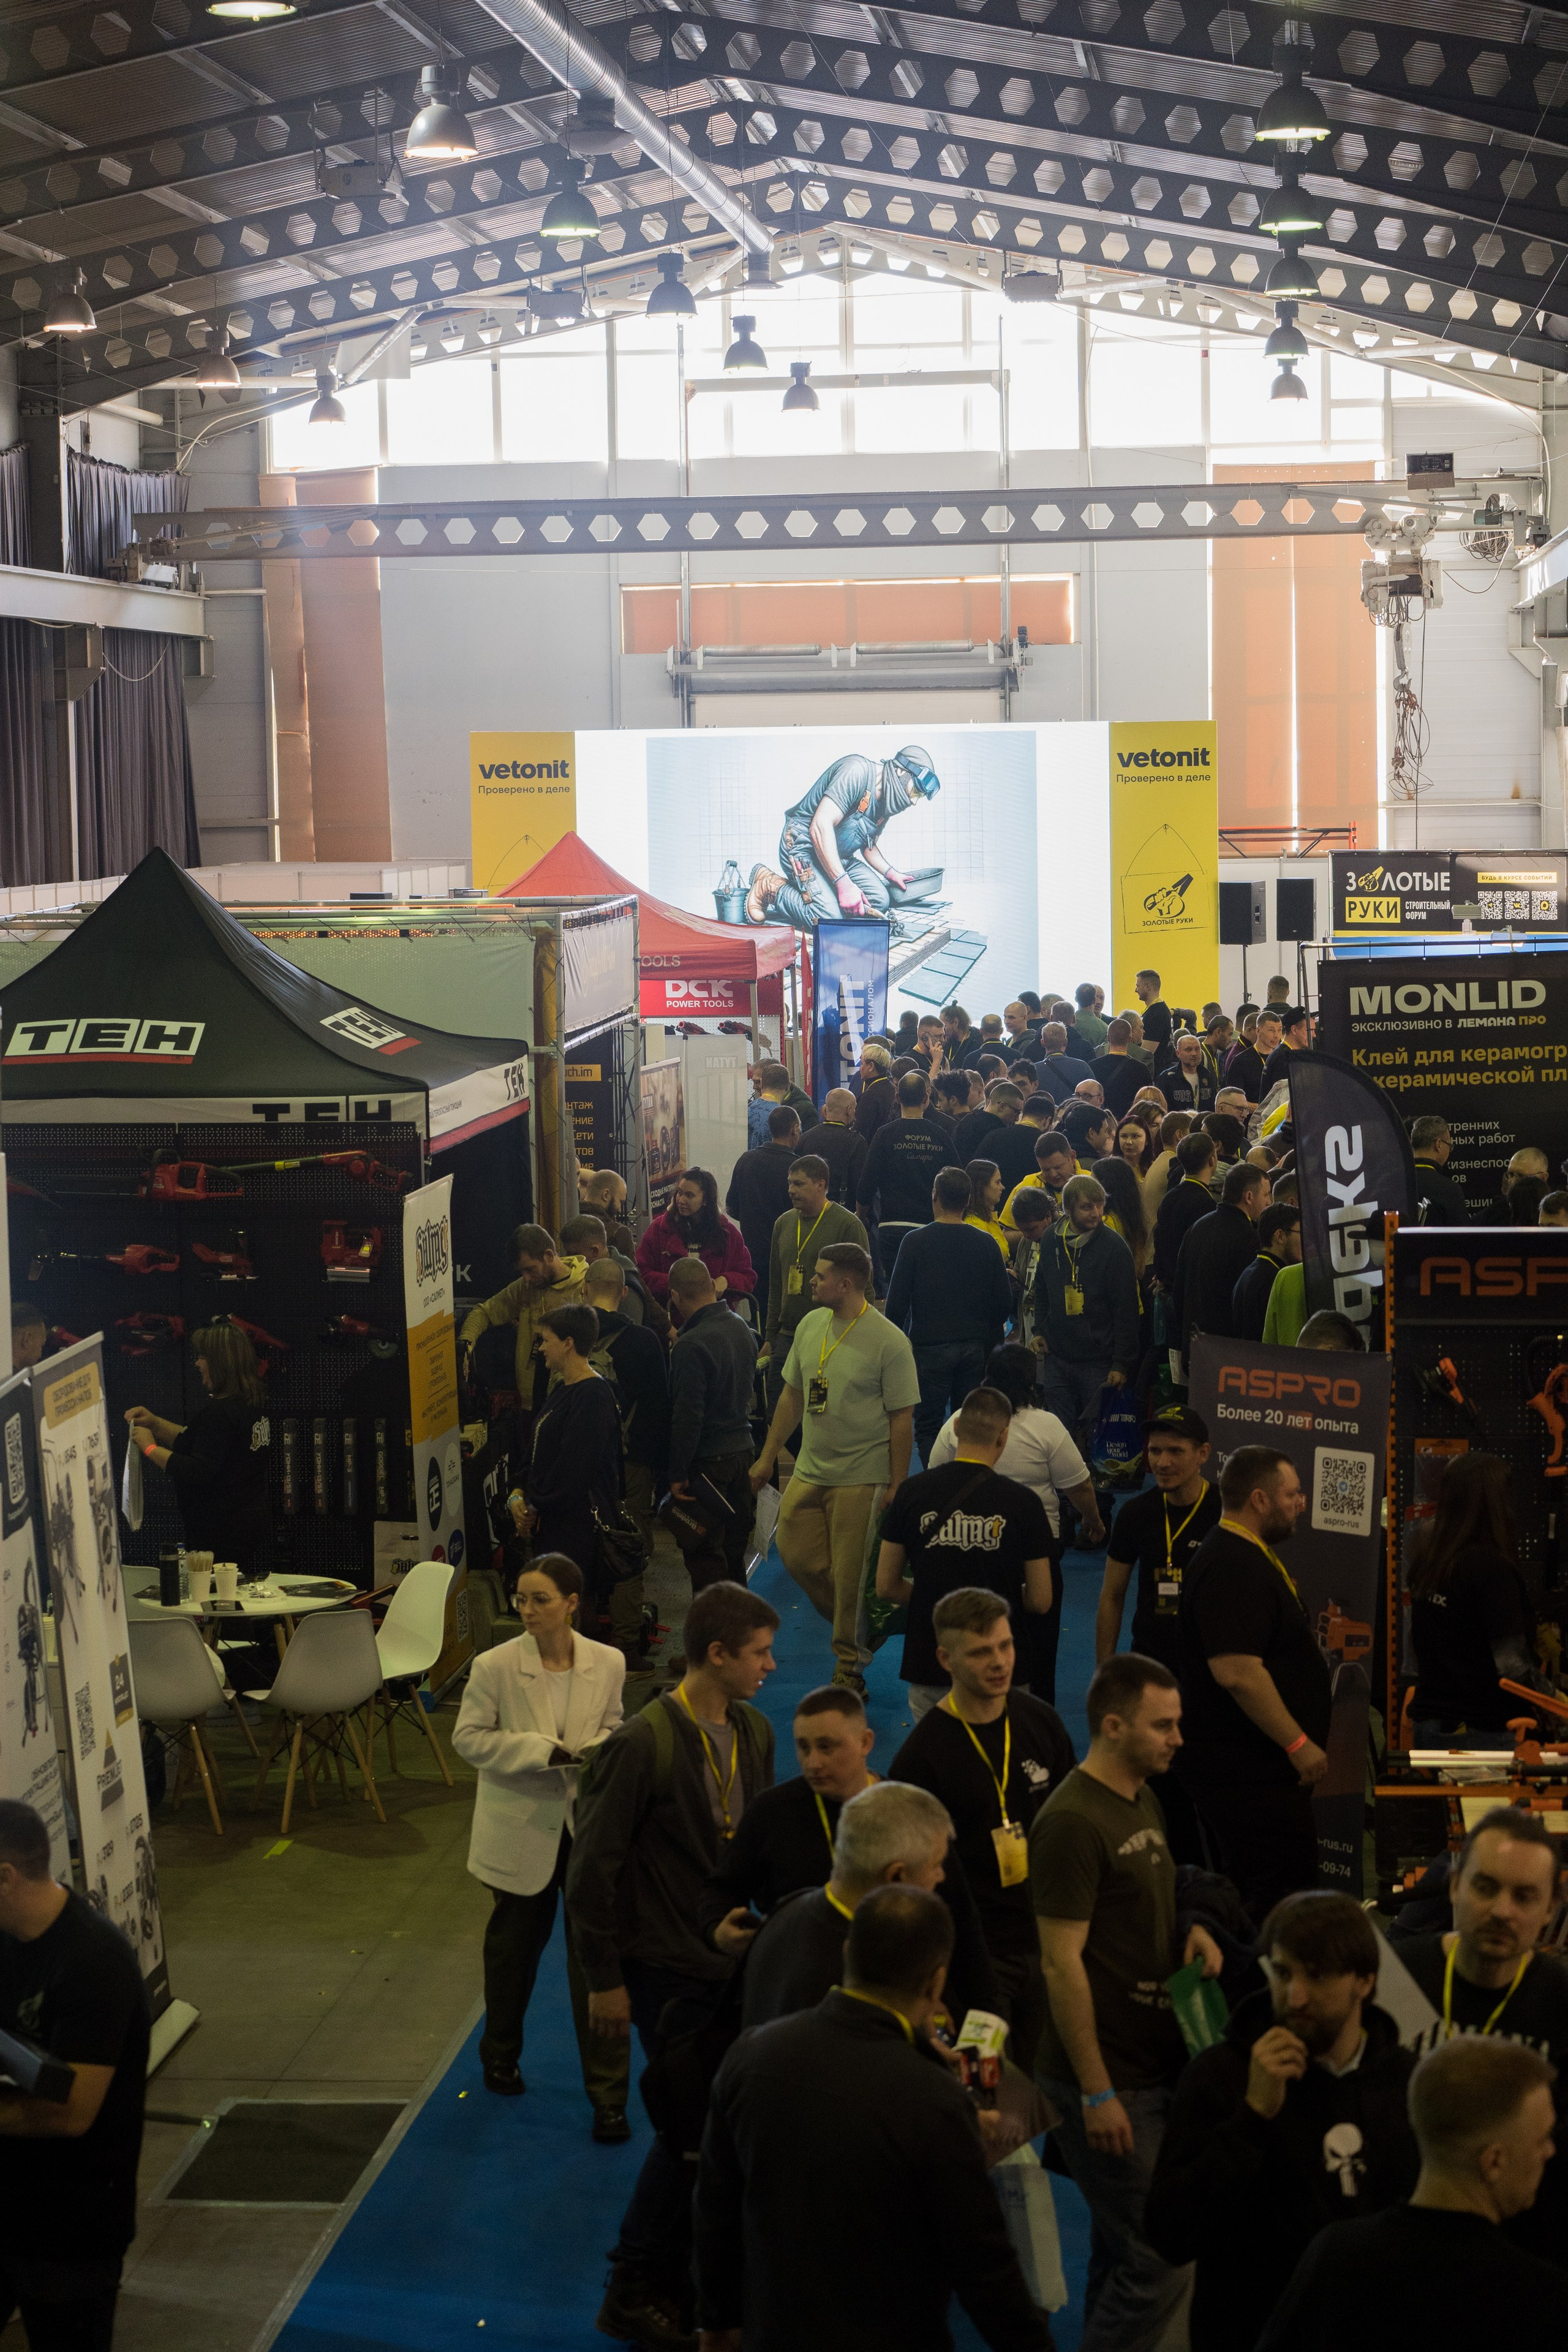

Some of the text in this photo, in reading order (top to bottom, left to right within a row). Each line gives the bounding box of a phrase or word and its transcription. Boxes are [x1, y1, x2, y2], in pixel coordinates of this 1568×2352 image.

[1117, 747, 1210, 767] vetonit
[478, 760, 570, 779] vetonit
[1117, 774, 1175, 784] Проверено
[478, 786, 535, 796] Проверено
[1348, 900, 1398, 919] РУКИ
[1405, 900, 1450, 910] СТРОИТЕЛЬНЫЙ
[1405, 911, 1427, 920] ФОРУМ
[639, 956, 680, 967] OOLS
[665, 980, 733, 998] DCK
[1349, 980, 1546, 1016] MONLID
[1351, 1016, 1547, 1032] ЭКСКЛЮЗИВНО В ЛЕМАНА ПРО
[1352, 1045, 1567, 1066] Клей для керамогр
[1373, 1066, 1534, 1092] керамической
[1447, 1121, 1500, 1133] тренних
[1479, 1133, 1515, 1146] работ
[1218, 1365, 1360, 1408] ASPRO
[1217, 1403, 1359, 1434] Более 20 лет опыта
[1323, 1518, 1360, 1529] aspro-rus
[1317, 1838, 1353, 1853] -rus.ru
[1318, 1861, 1351, 1877] -09-74
